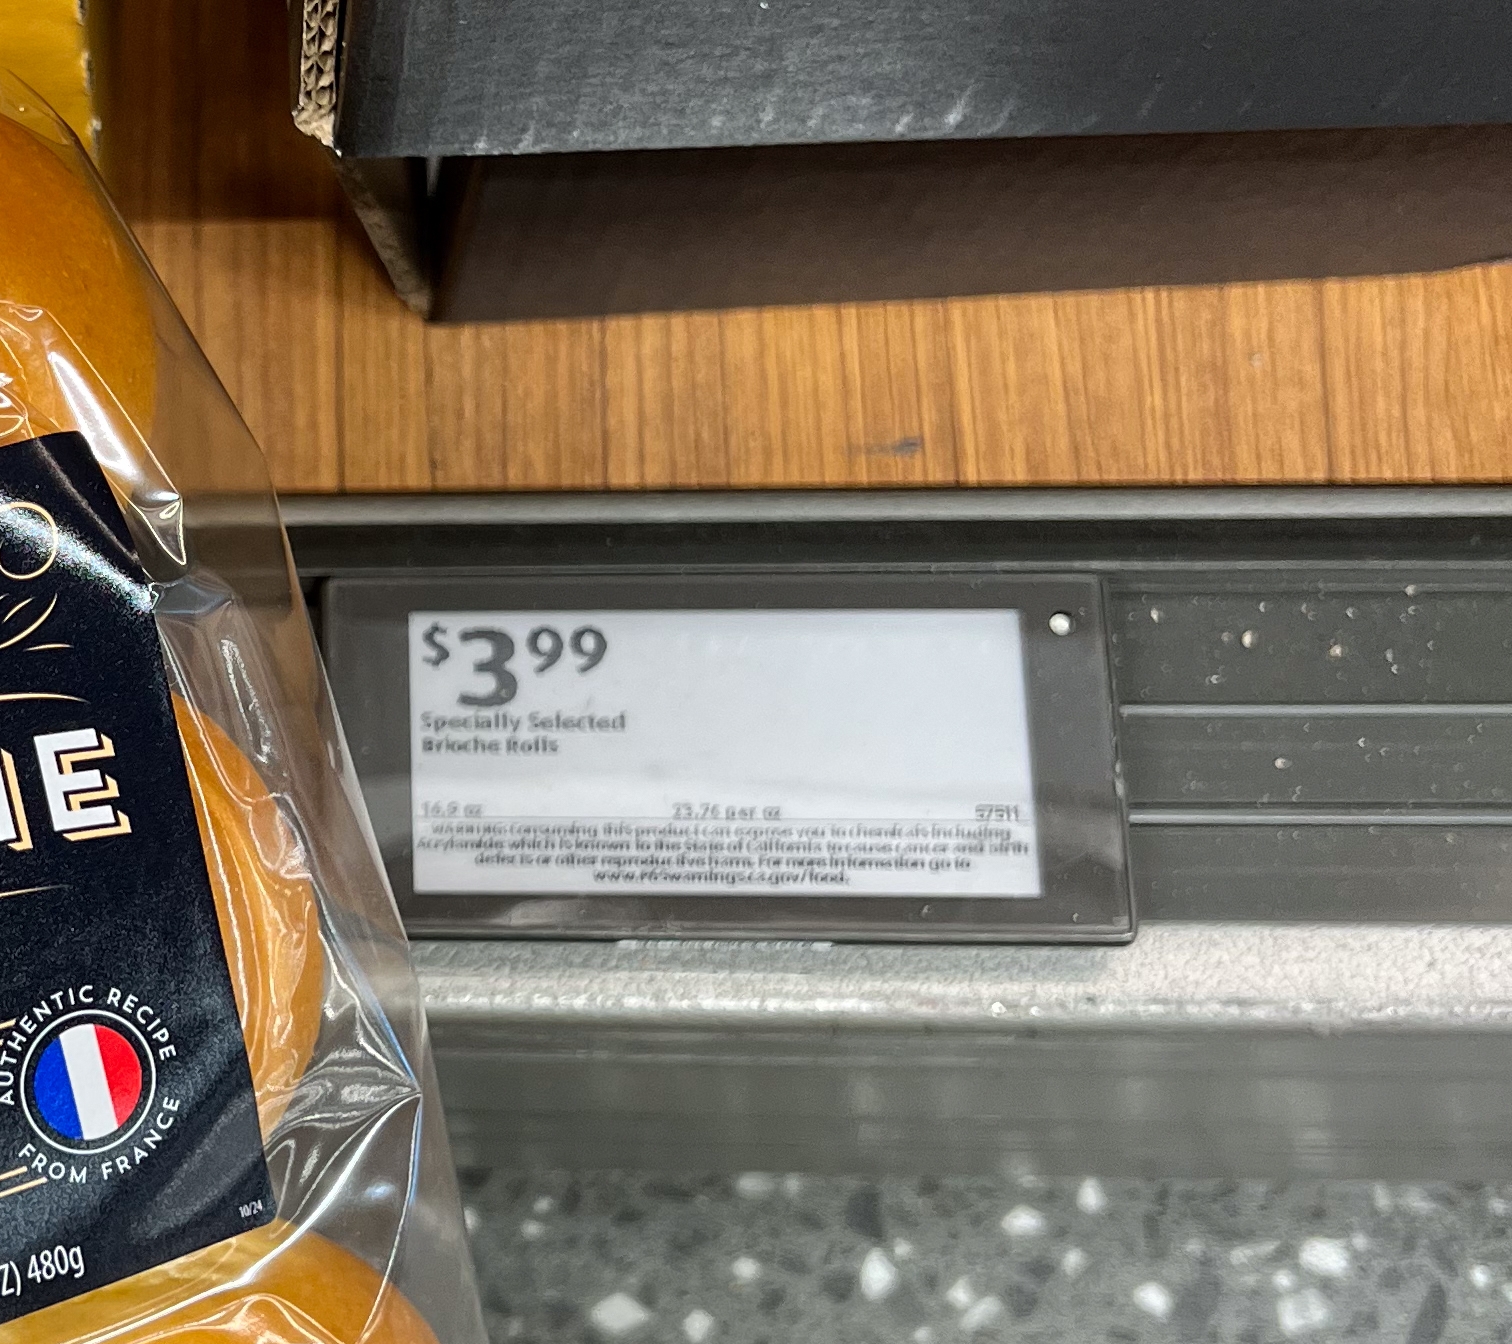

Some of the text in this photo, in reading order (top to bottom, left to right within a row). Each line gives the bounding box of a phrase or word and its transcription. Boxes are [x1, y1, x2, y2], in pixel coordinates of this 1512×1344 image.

[420, 709, 627, 733] Specially Selected
[106, 987, 177, 1062] RECIPE
[18, 1095, 181, 1185] FROM FRANCE
[26, 1244, 87, 1286] 480g
